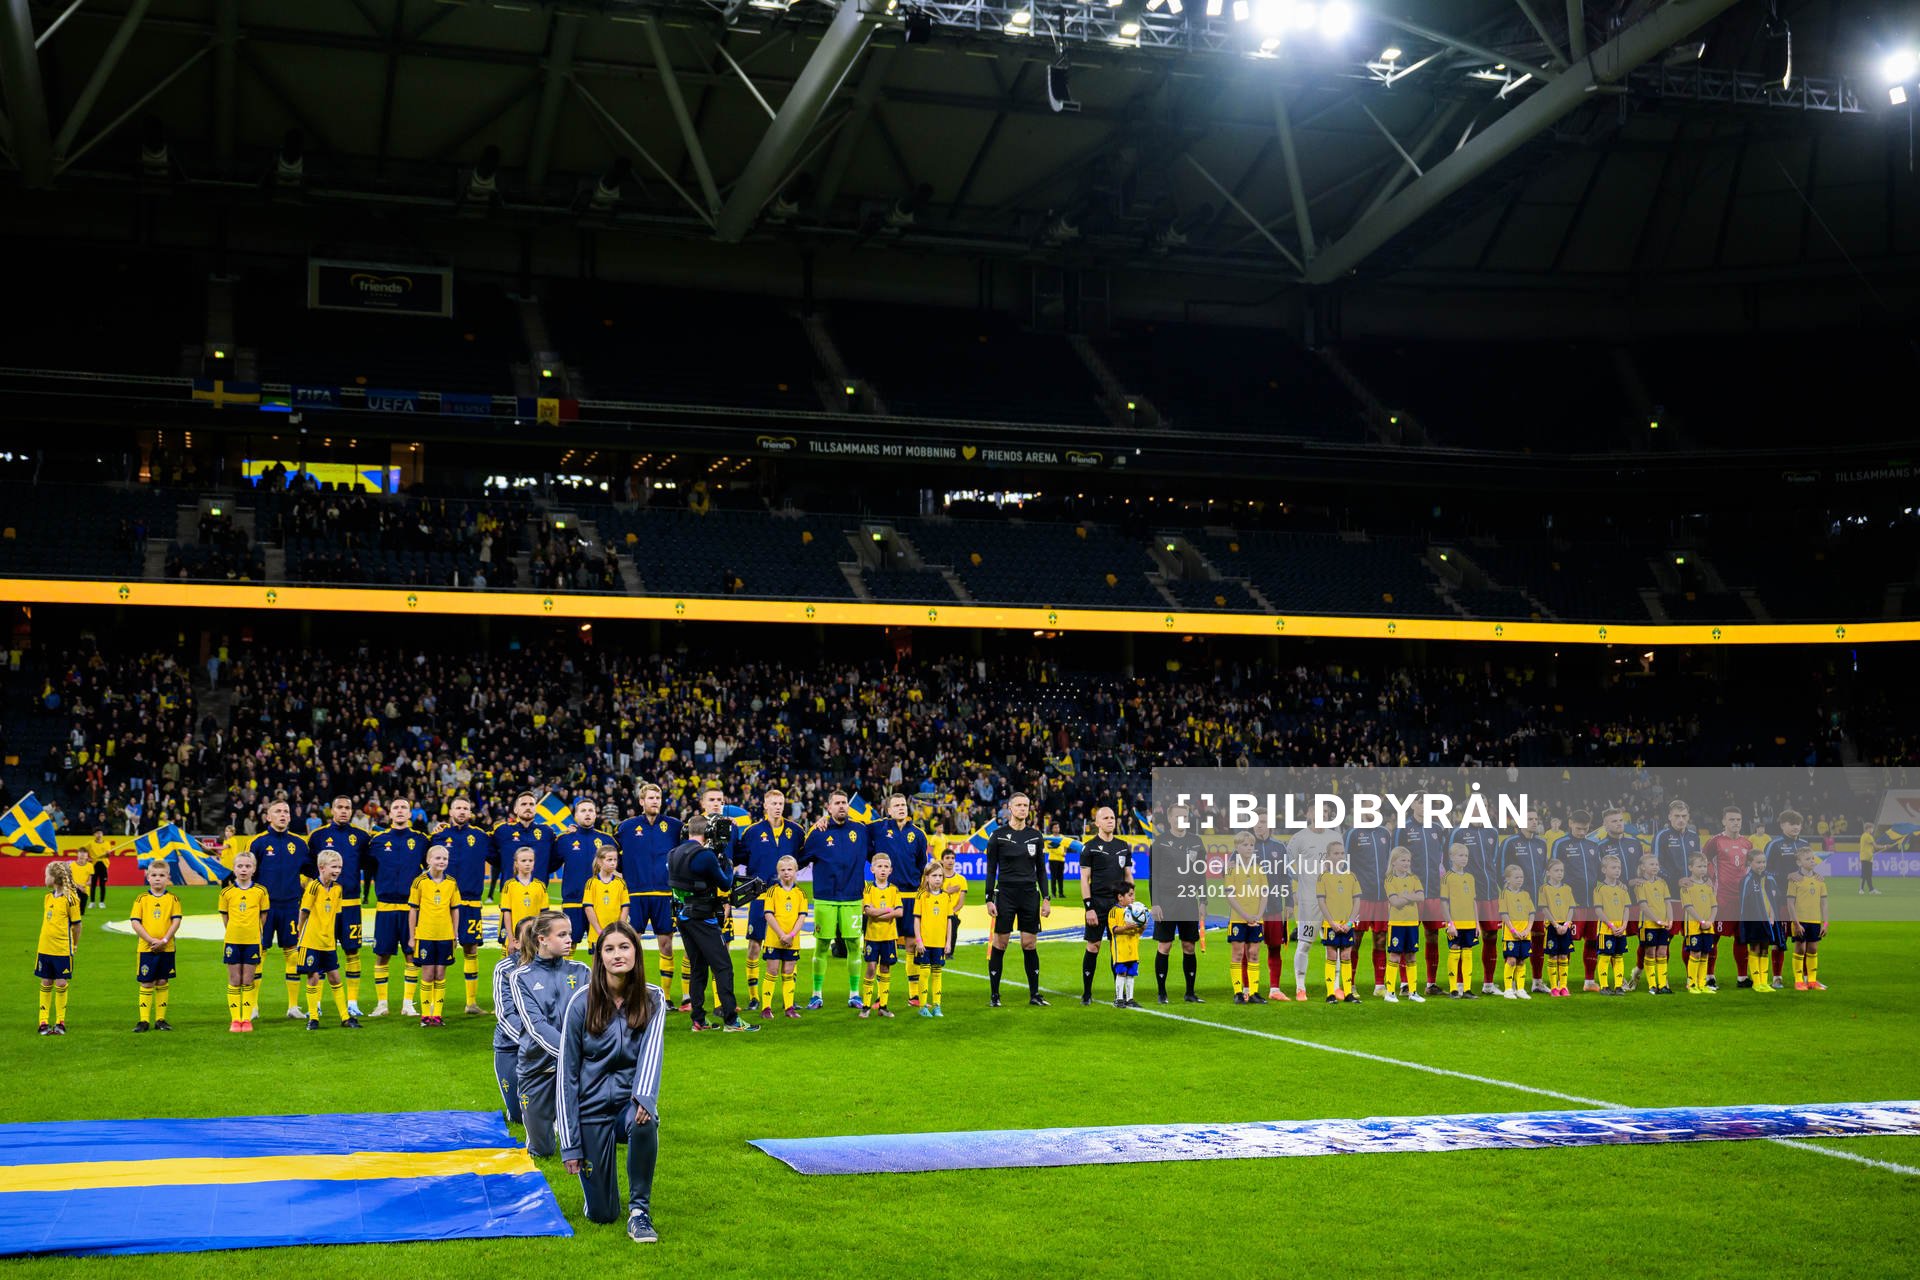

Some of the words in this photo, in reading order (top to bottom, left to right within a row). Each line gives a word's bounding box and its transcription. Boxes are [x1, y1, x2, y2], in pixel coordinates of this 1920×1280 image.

[360, 280, 403, 293] friends
[297, 388, 332, 401] FIFA
[368, 395, 415, 411] UEFA
[762, 439, 791, 450] friends
[809, 440, 880, 455] TILLSAMMANS
[882, 444, 902, 456] MOT
[905, 446, 957, 459] MOBBNING
[981, 449, 1023, 462] FRIENDS
[1025, 451, 1058, 464] ARENA
[467, 919, 482, 934] 24
[1303, 925, 1314, 937] 23
